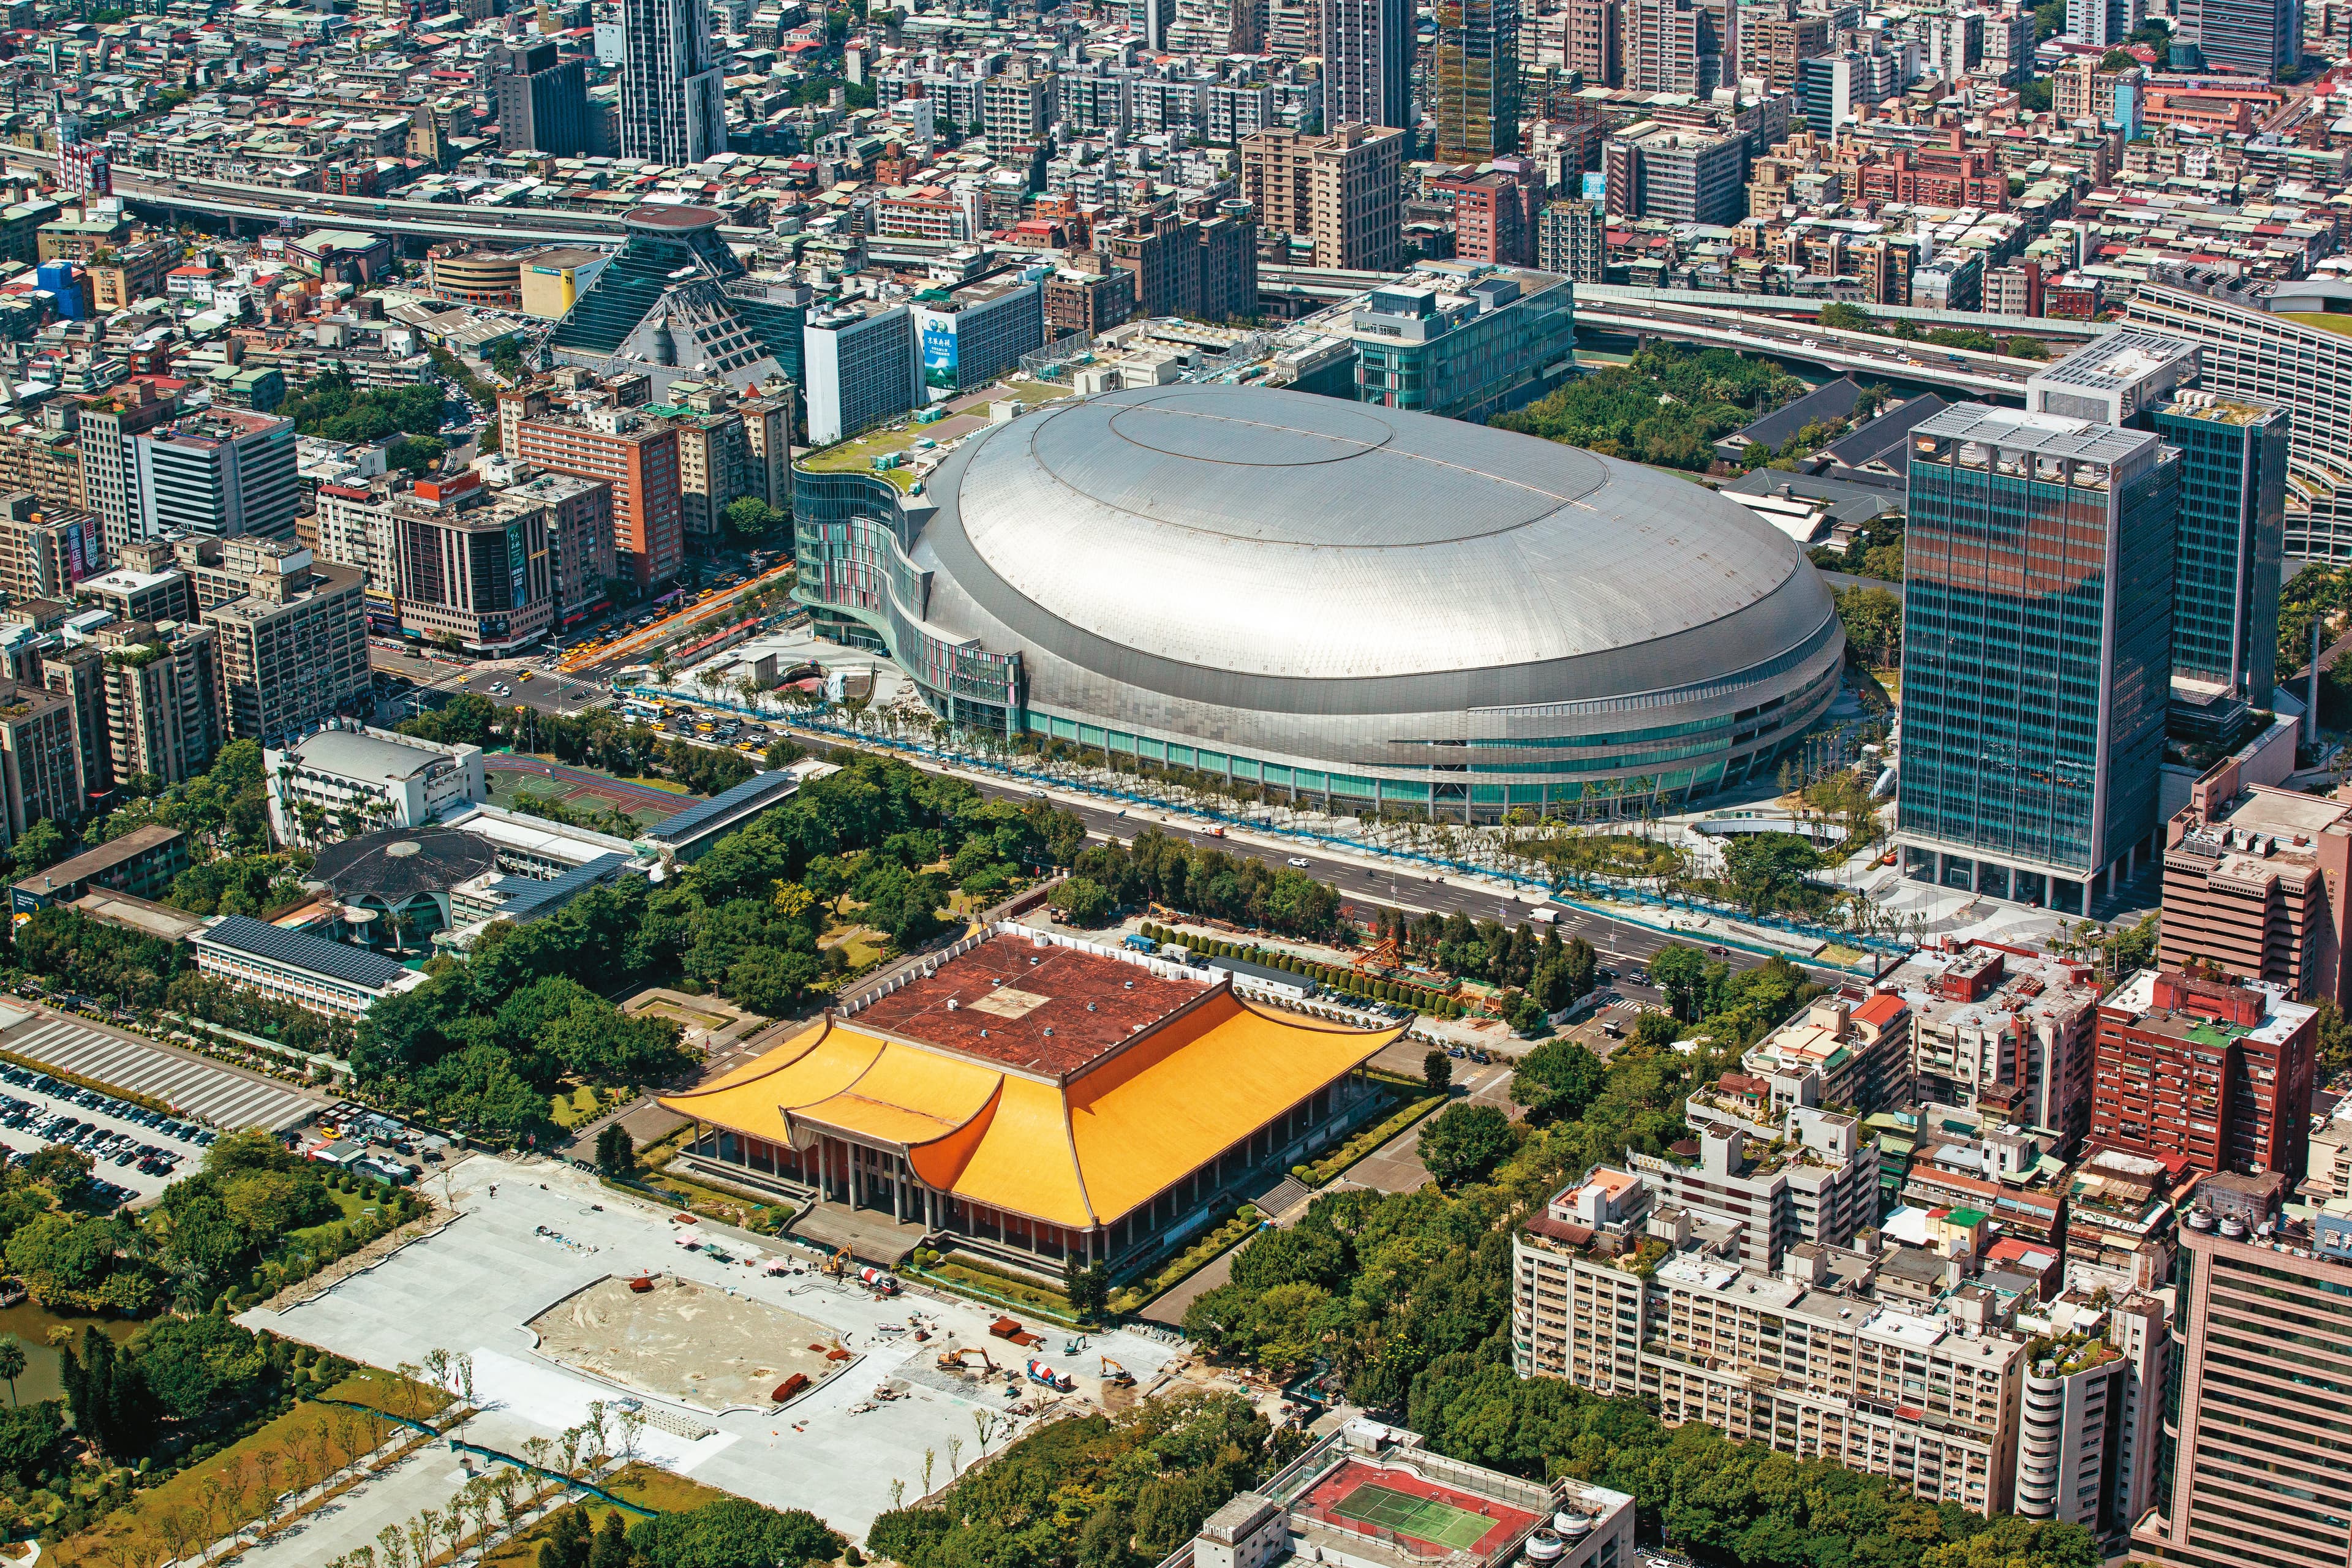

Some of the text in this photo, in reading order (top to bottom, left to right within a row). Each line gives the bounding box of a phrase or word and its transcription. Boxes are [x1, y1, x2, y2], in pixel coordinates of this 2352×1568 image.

[69, 527, 82, 573] 東區店面
[87, 551, 97, 560] 328
